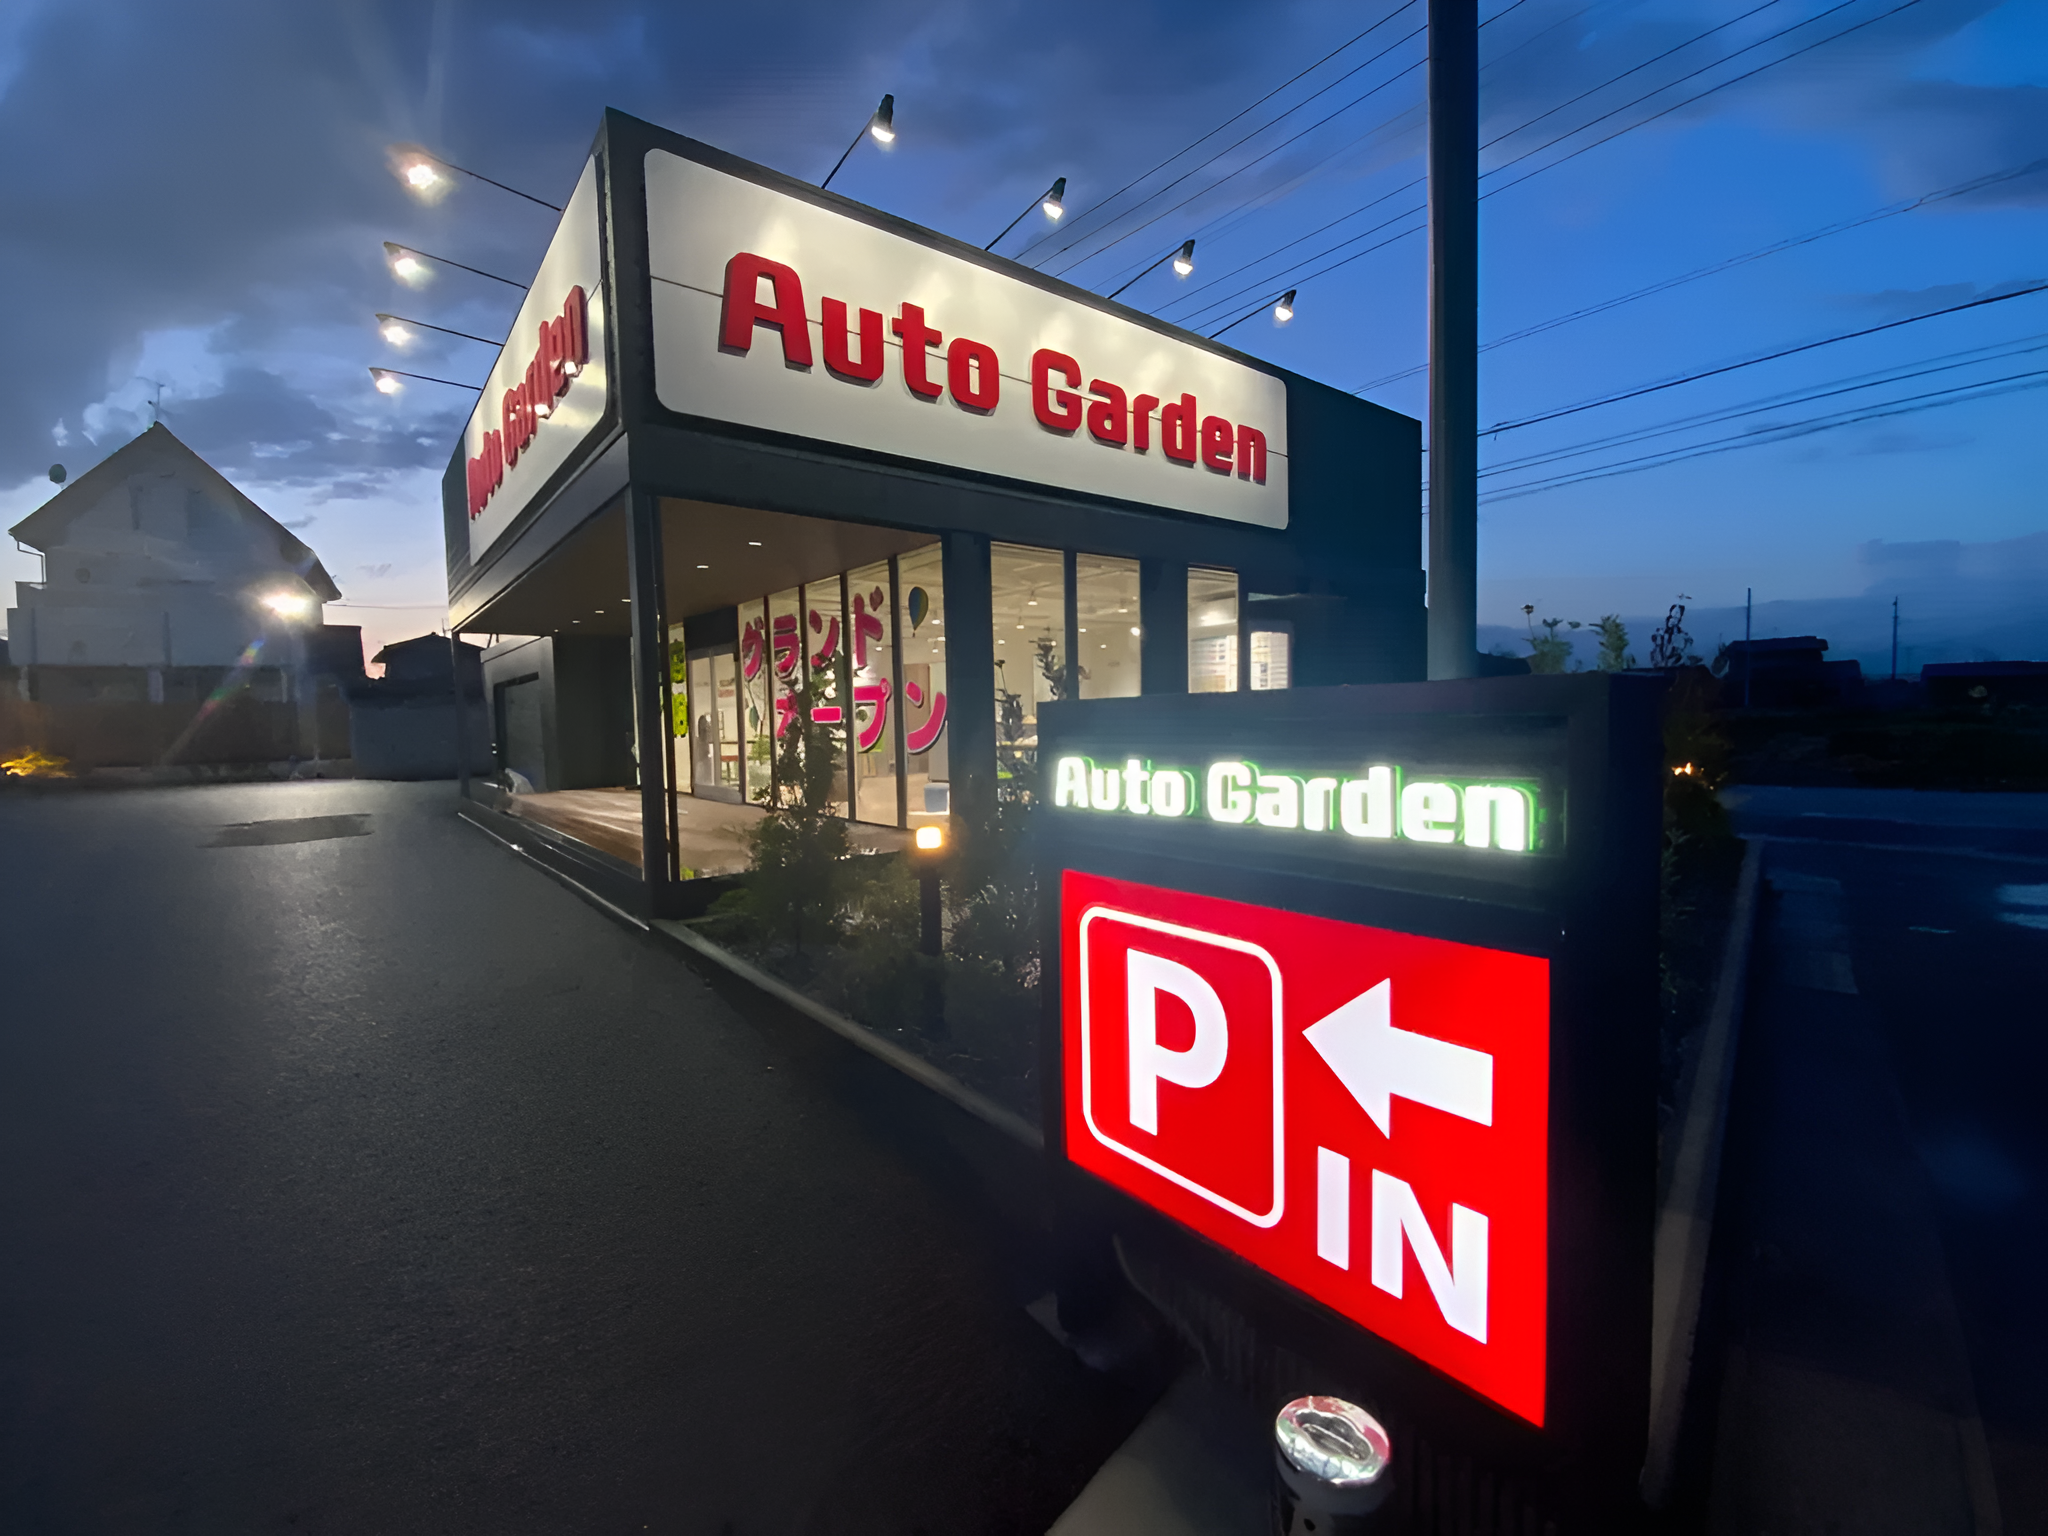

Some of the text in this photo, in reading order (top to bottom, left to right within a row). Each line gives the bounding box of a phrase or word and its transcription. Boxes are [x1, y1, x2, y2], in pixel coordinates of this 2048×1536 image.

[718, 252, 1266, 484] Auto Garden
[742, 586, 884, 681] グランド
[1054, 756, 1528, 852] Auto Garden
[1127, 948, 1229, 1136] P
[1317, 1145, 1489, 1345] IN
